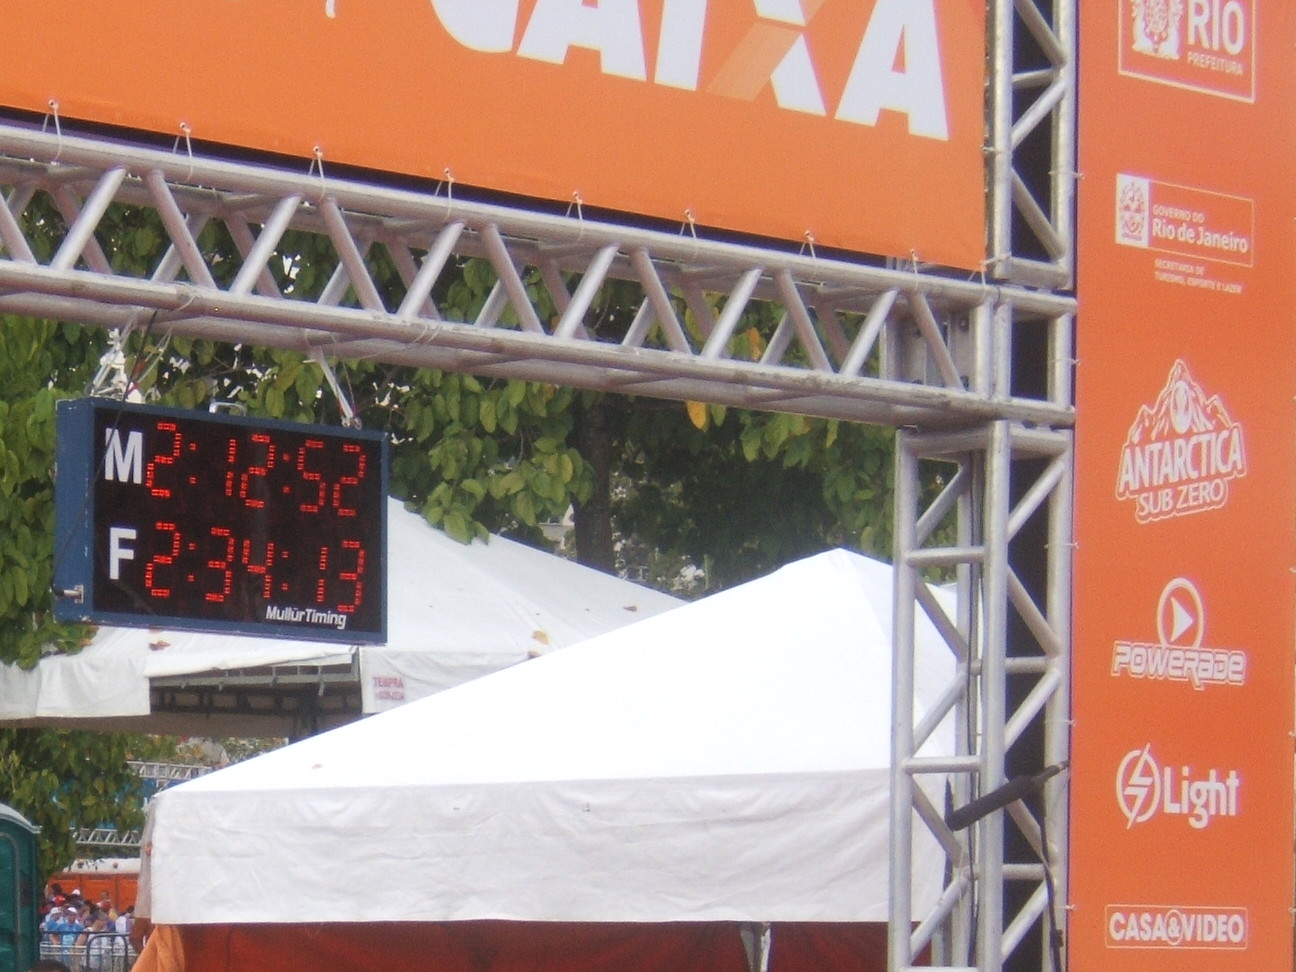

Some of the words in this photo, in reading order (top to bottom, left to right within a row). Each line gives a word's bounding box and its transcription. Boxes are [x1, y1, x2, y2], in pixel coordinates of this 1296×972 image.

[1187, 0, 1246, 55] RIO
[1186, 51, 1245, 77] PREFEITURA
[1152, 217, 1176, 240] Rio
[1177, 222, 1197, 244] de
[1196, 226, 1249, 254] Janeiro
[104, 427, 144, 485] M
[145, 421, 368, 517] 2:12:52
[1118, 426, 1245, 494] ANTARCTICA
[1138, 489, 1174, 517] SUB
[1176, 478, 1226, 509] ZERO
[108, 526, 137, 581] F
[144, 521, 366, 614] 2:34:13
[1111, 643, 1246, 689] POWERADE
[1163, 766, 1241, 829] Light
